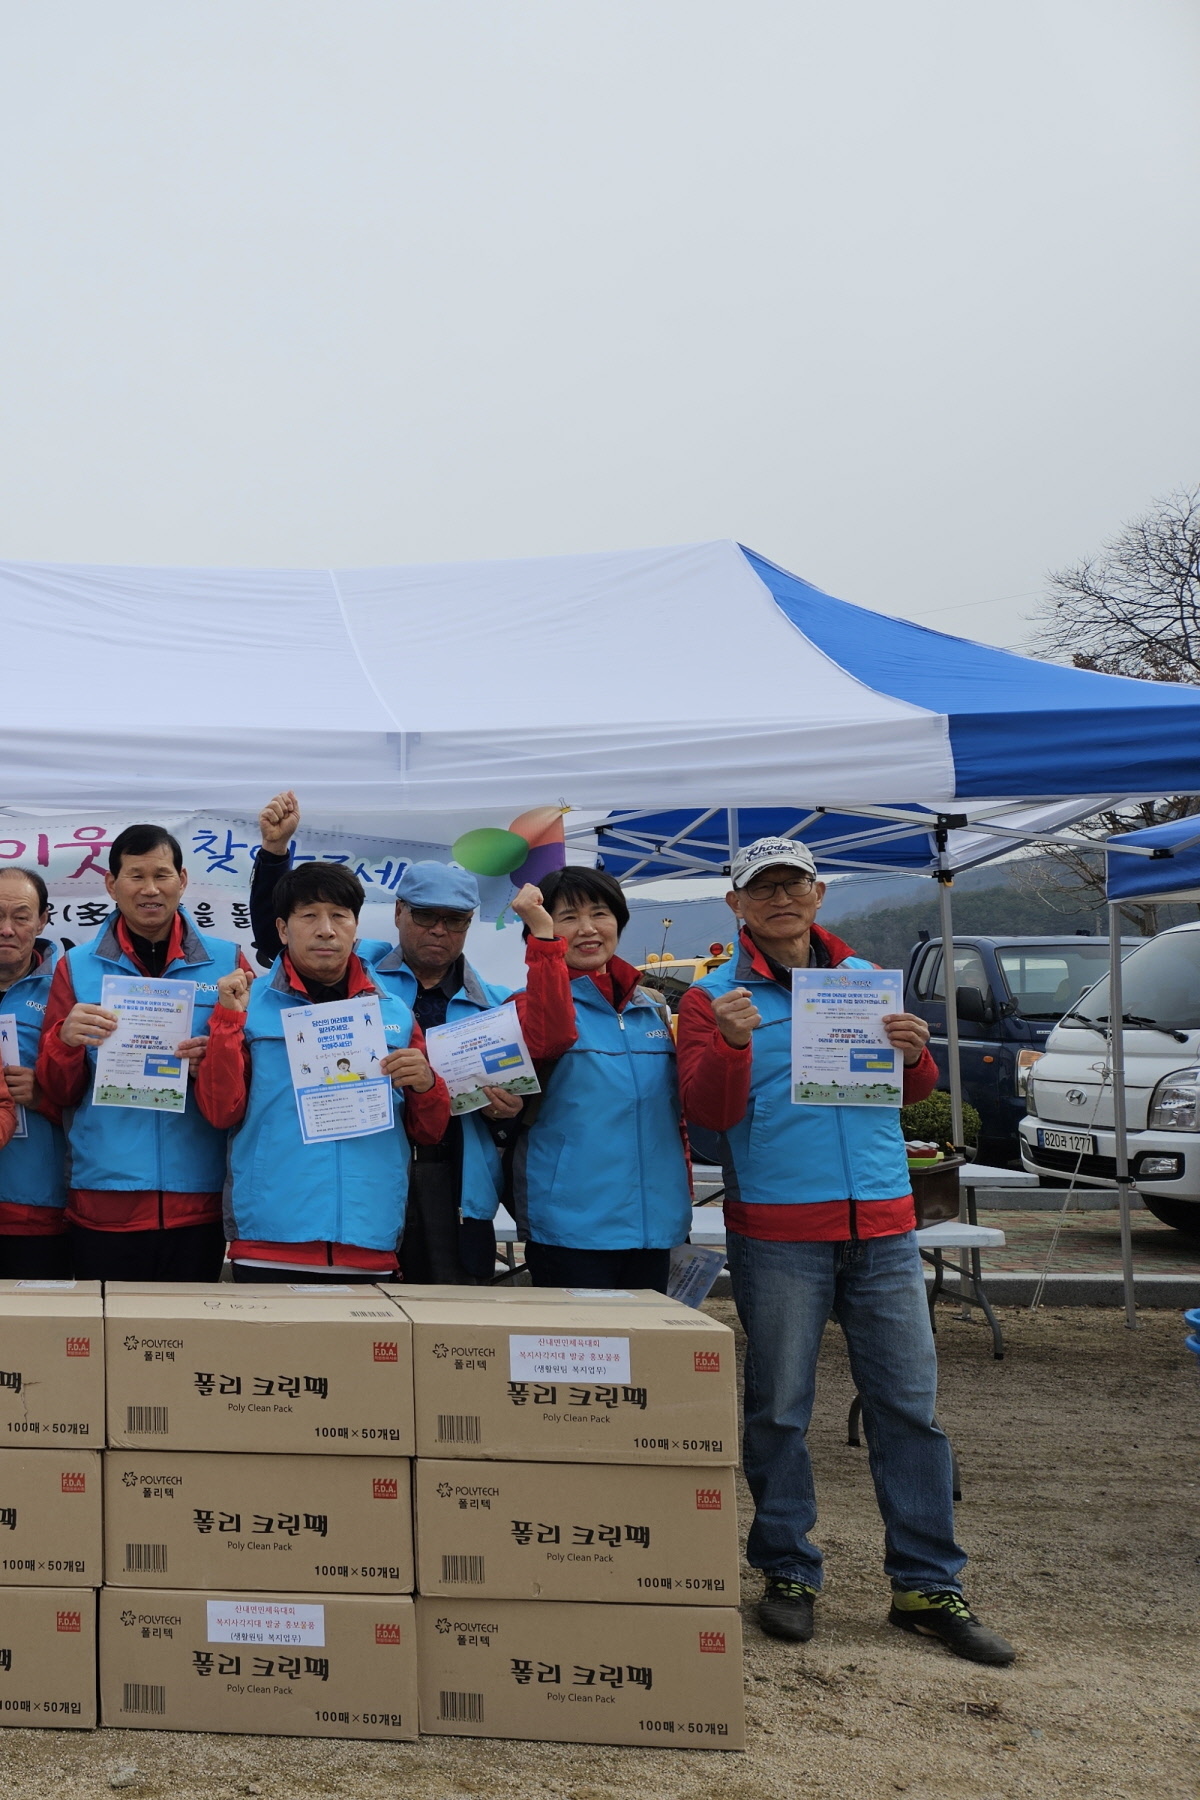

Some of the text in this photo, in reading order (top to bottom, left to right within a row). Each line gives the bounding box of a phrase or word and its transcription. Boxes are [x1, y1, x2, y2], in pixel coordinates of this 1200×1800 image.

[1069, 1136, 1091, 1152] 1277
[142, 1339, 183, 1348] POLYTECH
[144, 1351, 174, 1362] 폴리텍
[452, 1348, 495, 1357] POLYTECH
[519, 1351, 565, 1360] 복지사각지대
[569, 1352, 585, 1361] 발굴
[455, 1359, 486, 1370] 폴리텍
[194, 1372, 328, 1399] 폴리 크린팩
[507, 1381, 647, 1410] 폴리 크린팩
[228, 1404, 245, 1413] Poly
[248, 1404, 271, 1412] Clean
[543, 1413, 610, 1423] Poly Clean Pack
[140, 1476, 182, 1485] POLYTECH
[143, 1488, 173, 1498] 폴리텍
[456, 1487, 499, 1496] POLYTECH
[459, 1499, 490, 1509] 폴리텍
[193, 1509, 327, 1537] 폴리 크린팩
[511, 1521, 649, 1548] 폴리 크린팩
[228, 1541, 245, 1551] Poly
[547, 1553, 613, 1562] Poly Clean Pack
[139, 1615, 181, 1625] POLYTECH
[216, 1619, 261, 1628] 복지사각지대
[266, 1620, 281, 1629] 발굴
[454, 1622, 498, 1632] POLYTECH
[142, 1627, 172, 1639] 폴리텍
[457, 1635, 489, 1647] 폴리텍
[193, 1651, 328, 1681] 폴리 크린팩
[511, 1659, 652, 1690] 폴리 크린팩
[227, 1684, 292, 1694] Poly Clean Pack
[548, 1693, 615, 1703] Poly Clean Pack
